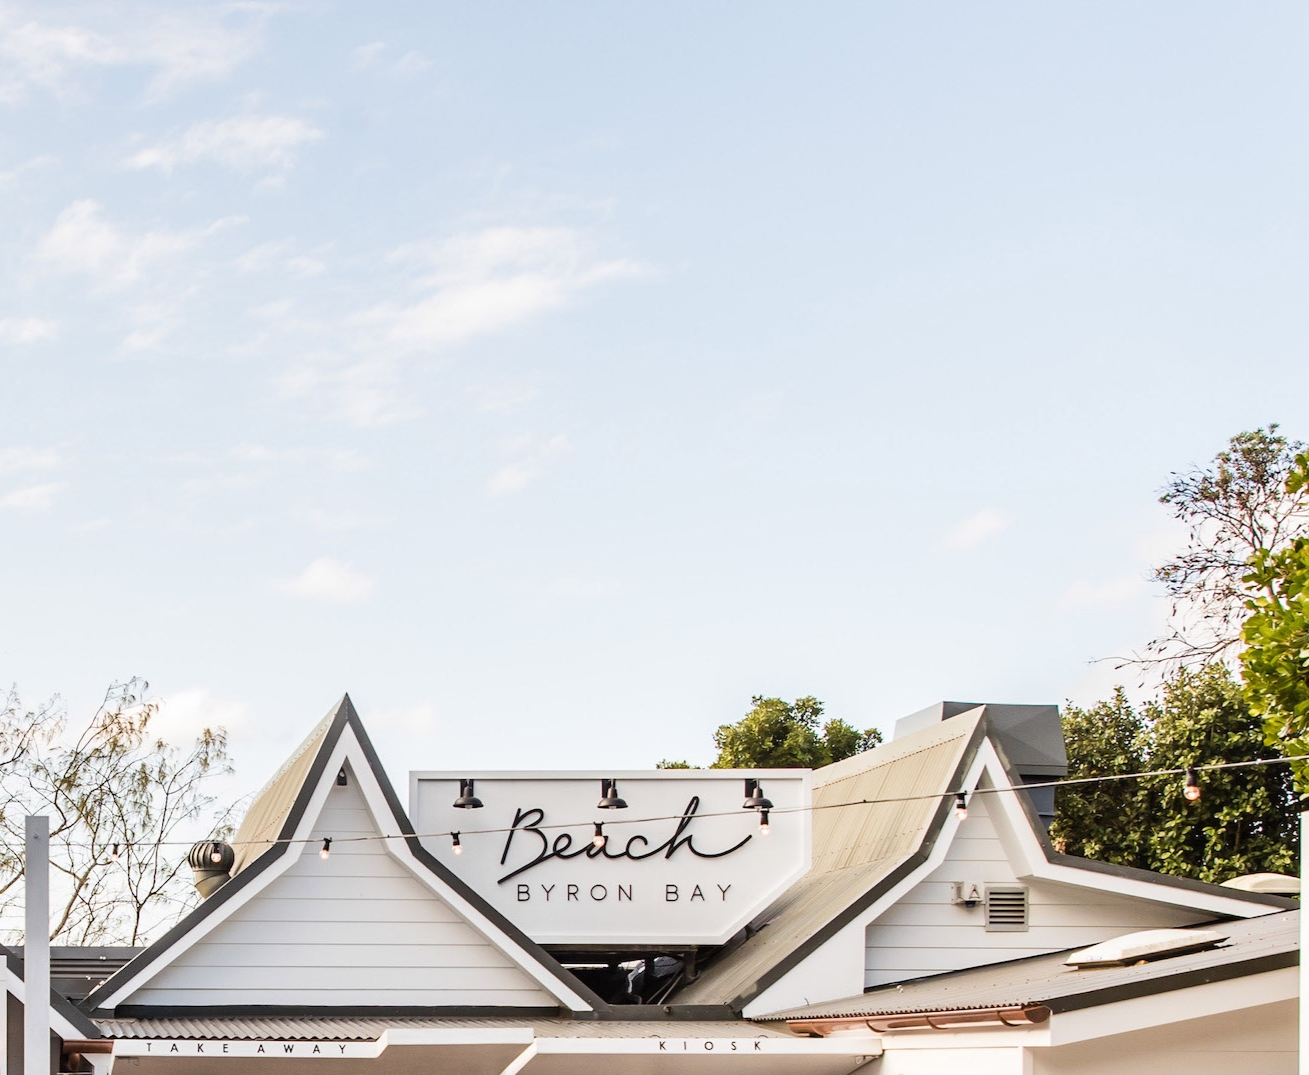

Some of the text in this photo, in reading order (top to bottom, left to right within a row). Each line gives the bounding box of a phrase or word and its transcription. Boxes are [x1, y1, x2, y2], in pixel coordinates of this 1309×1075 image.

[497, 795, 753, 885] Beach
[517, 884, 732, 903] BYRON BAY
[146, 1043, 347, 1054] TAKE AWAY
[659, 1041, 761, 1051] KIOSK
